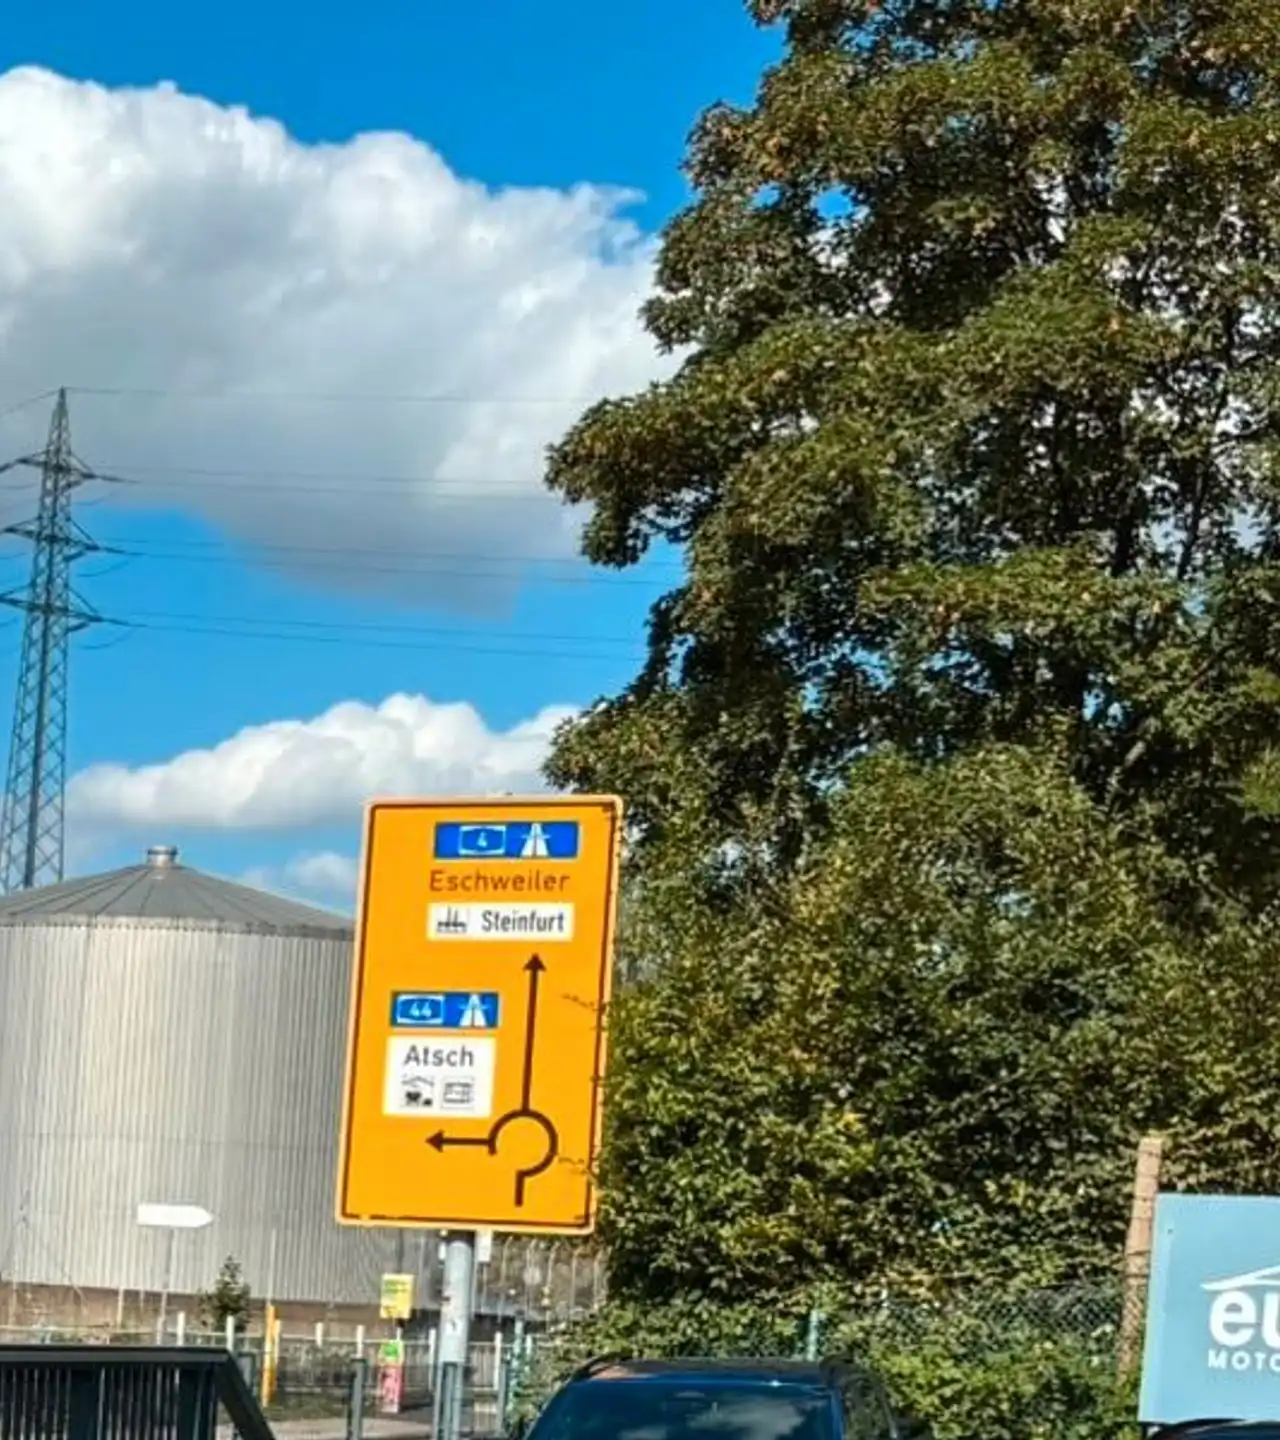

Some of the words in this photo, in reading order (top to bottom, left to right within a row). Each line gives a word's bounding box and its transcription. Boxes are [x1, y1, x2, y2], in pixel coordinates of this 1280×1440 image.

[476, 831, 488, 848] 4
[429, 868, 571, 892] Eschweiler
[481, 908, 565, 932] Steinfurt
[409, 1001, 432, 1018] 44
[403, 1044, 474, 1067] Atsch
